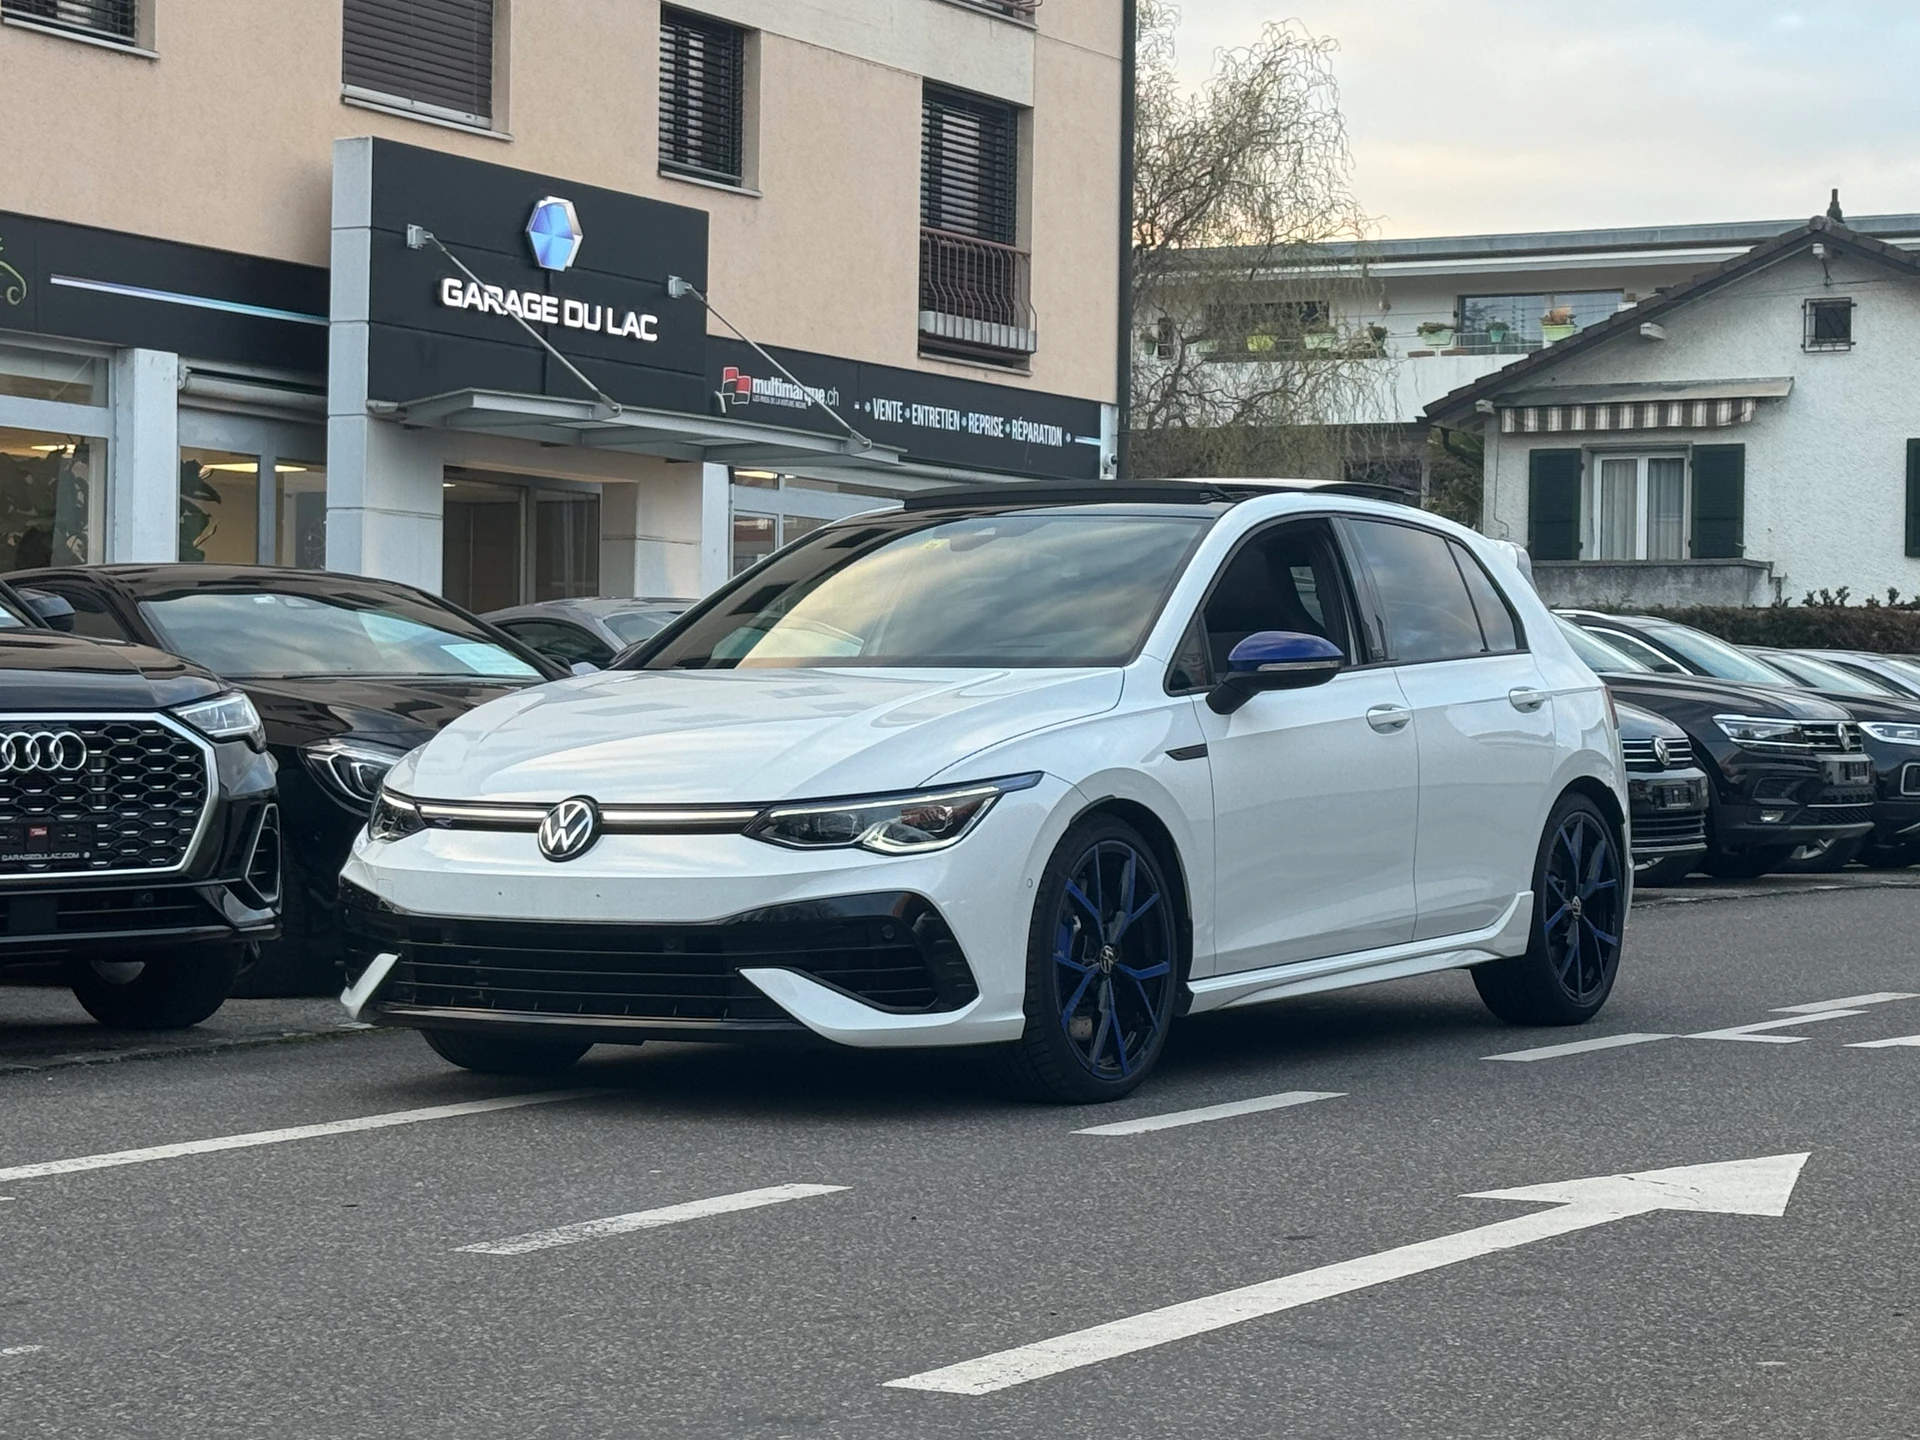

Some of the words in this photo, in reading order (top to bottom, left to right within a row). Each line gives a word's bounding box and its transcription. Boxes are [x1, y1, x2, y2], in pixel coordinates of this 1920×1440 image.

[441, 278, 558, 324] GARAGE
[563, 300, 601, 331] DU
[606, 307, 658, 341] LAC
[873, 398, 903, 423] VENTE
[911, 405, 960, 432] ENTRETIEN
[968, 412, 1004, 438] REPRISE
[1012, 416, 1063, 447] RÉPARATION
